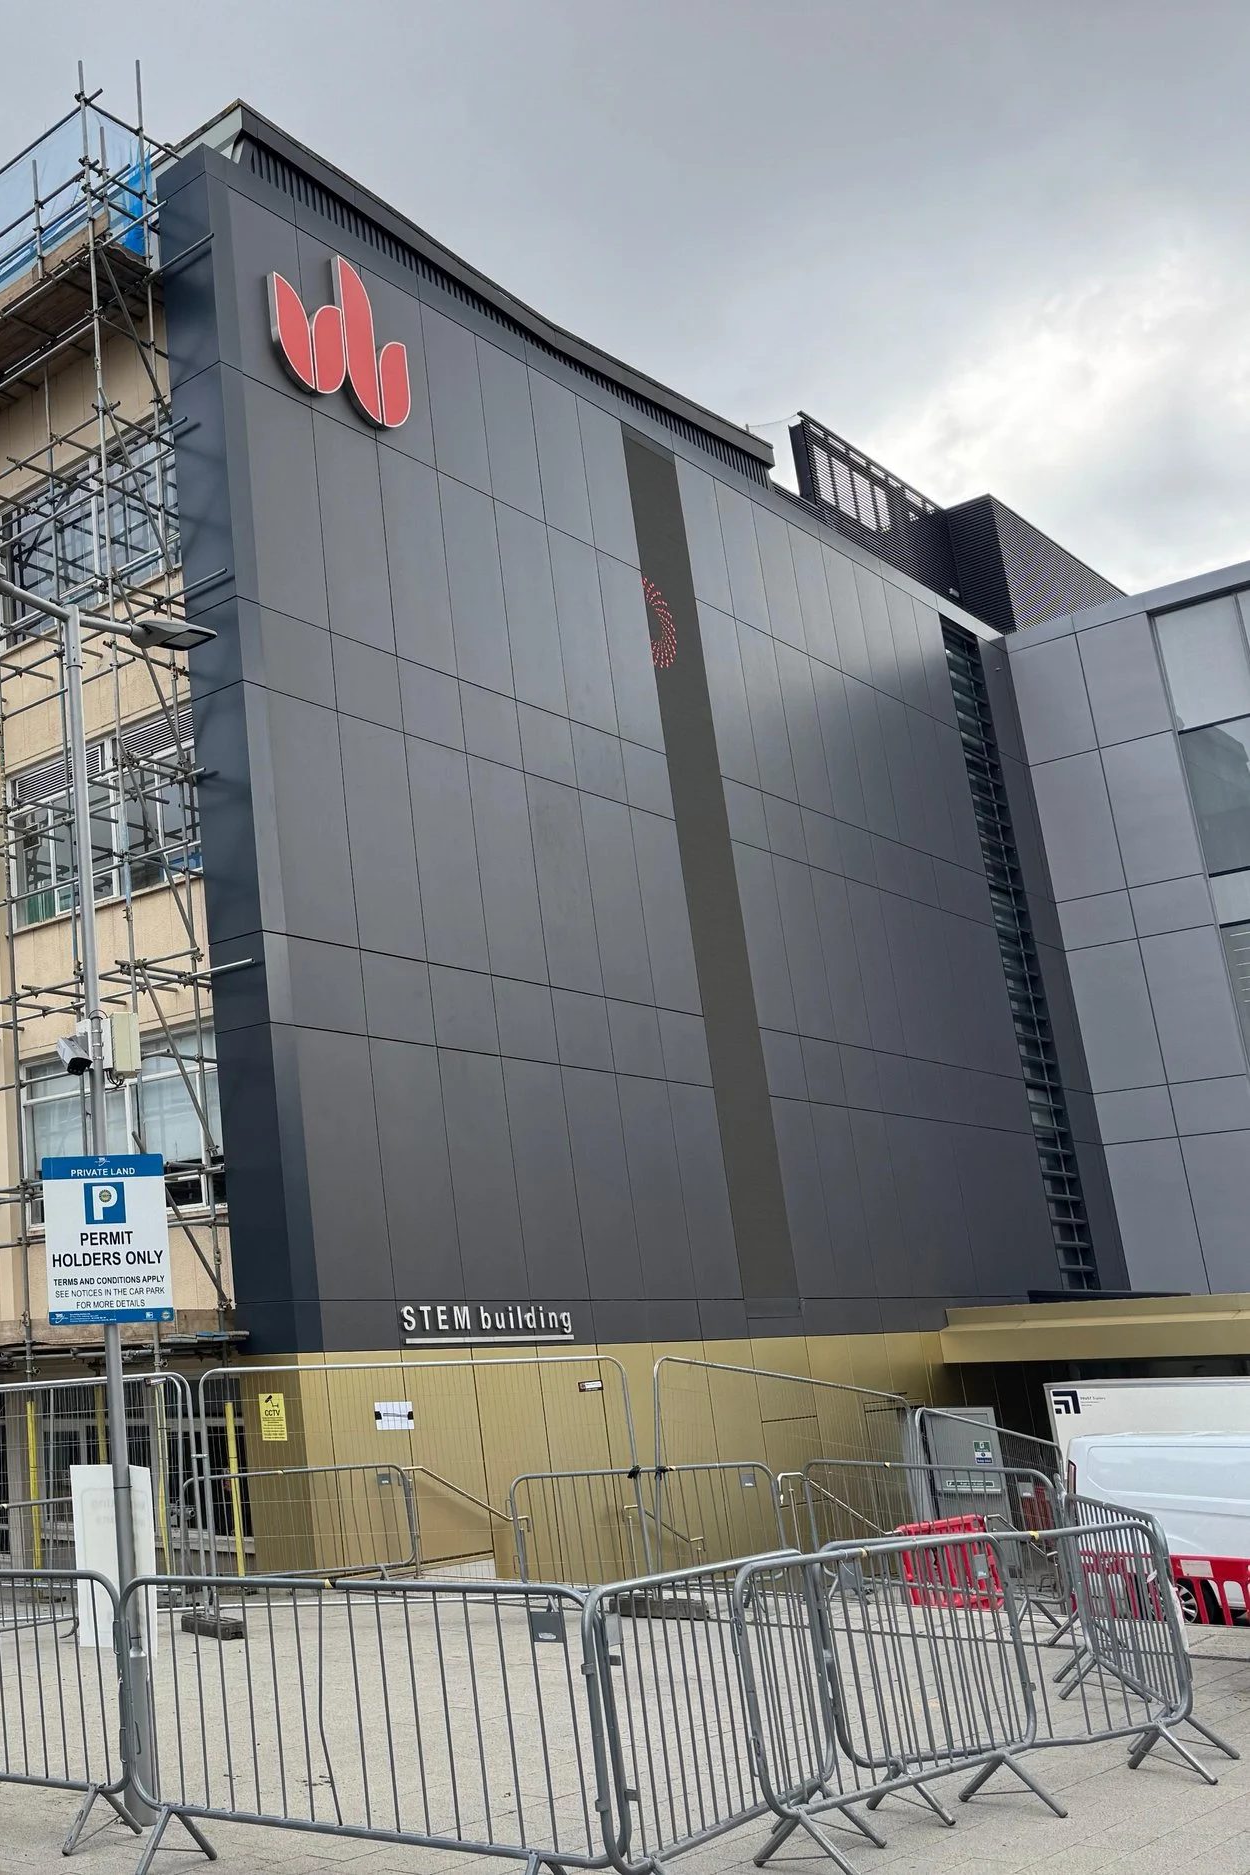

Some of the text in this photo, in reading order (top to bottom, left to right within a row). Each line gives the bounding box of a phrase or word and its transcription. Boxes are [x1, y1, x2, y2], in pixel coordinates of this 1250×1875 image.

[70, 1167, 136, 1177] PRIVATE LAND
[91, 1185, 118, 1221] P
[80, 1231, 133, 1246] PERMIT
[52, 1250, 164, 1268] HOLDERS ONLY
[53, 1275, 165, 1287] TERMS AND CONDITIONS APPLY
[55, 1286, 166, 1298] SEE NOTICES IN THE CAR PARK
[76, 1299, 146, 1309] FOR MORE DETAILS
[401, 1305, 572, 1334] STEM building
[264, 1409, 281, 1417] CCTV
